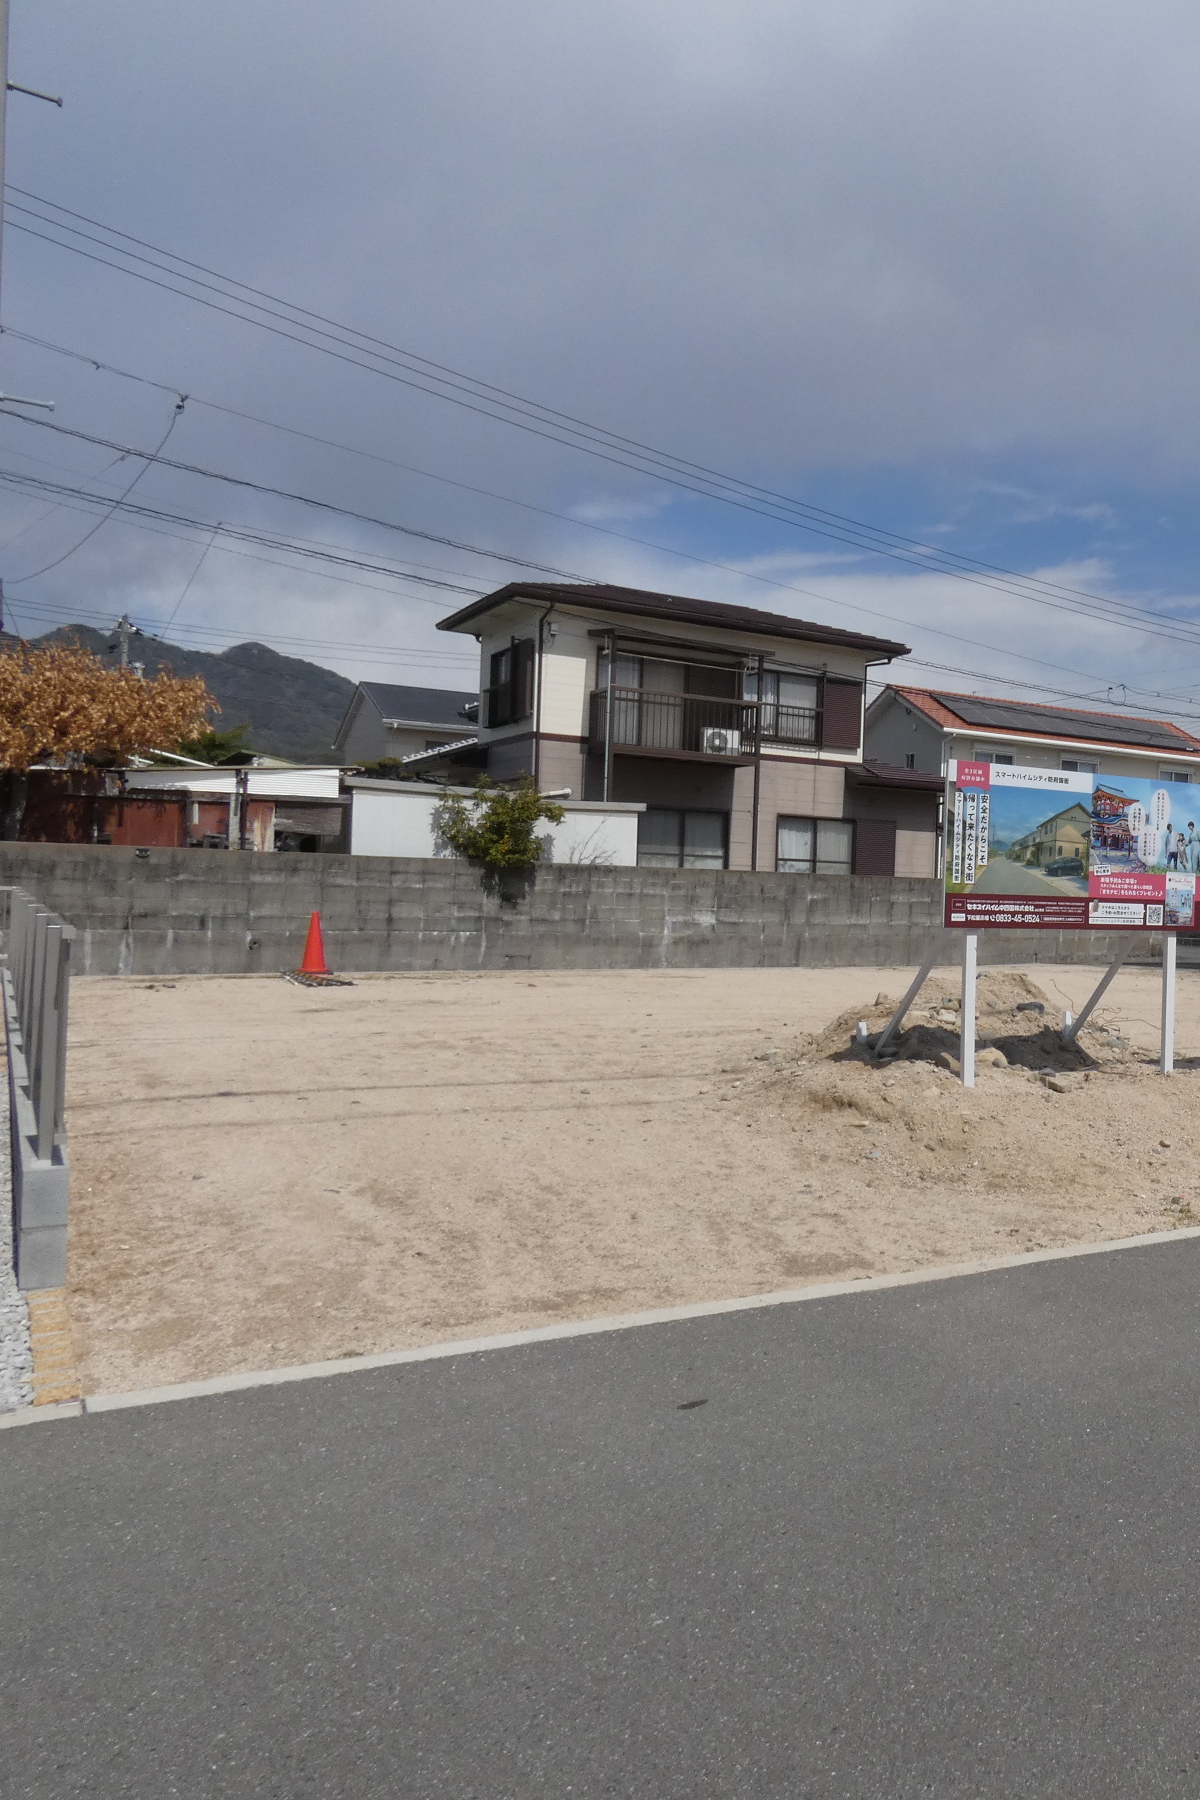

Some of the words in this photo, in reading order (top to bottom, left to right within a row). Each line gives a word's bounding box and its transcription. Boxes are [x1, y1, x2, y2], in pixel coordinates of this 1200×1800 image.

[965, 793, 976, 882] 帰って来たくなる街
[979, 795, 989, 863] 安全だからこそ
[995, 914, 1040, 923] 0833-45-0524
